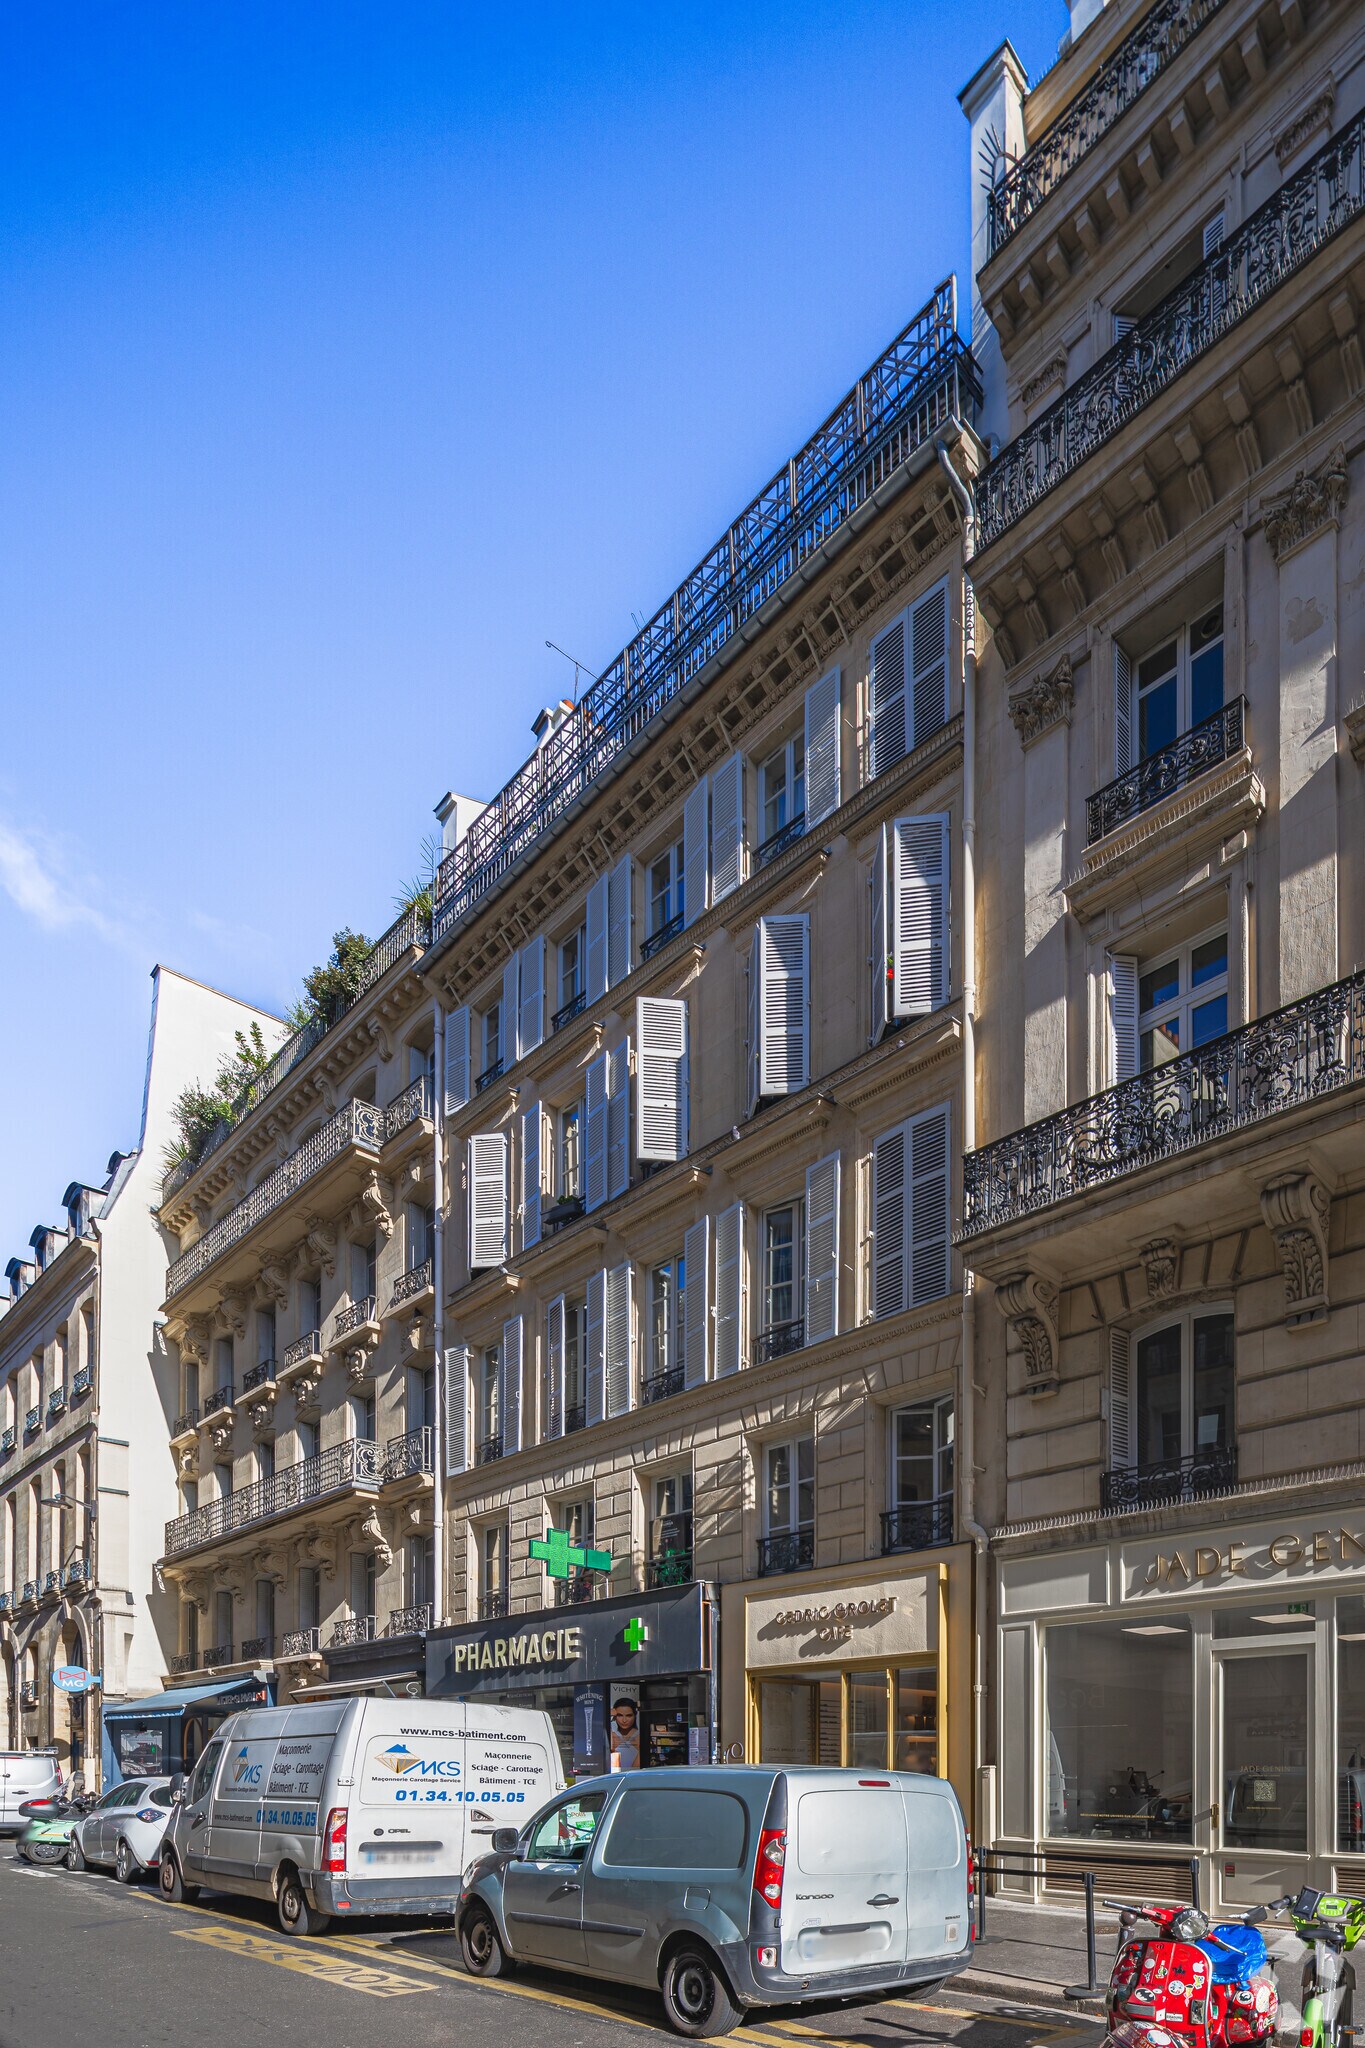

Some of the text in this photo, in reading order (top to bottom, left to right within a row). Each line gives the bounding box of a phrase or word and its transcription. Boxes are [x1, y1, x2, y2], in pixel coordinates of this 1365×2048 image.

[1145, 1540, 1245, 1584] JADE
[833, 1596, 899, 1619] GROLET
[454, 1626, 582, 1673] PHARMACIE
[61, 1679, 84, 1688] MG
[400, 1727, 527, 1741] www.mcs-batiment.com
[278, 1743, 312, 1757] Maçonnerie
[484, 1751, 532, 1761] Maçonnerie
[236, 1764, 263, 1784] MCS
[272, 1762, 292, 1777] Sciage
[295, 1762, 324, 1775] Carottage
[403, 1760, 461, 1777] MCS
[471, 1764, 499, 1773] Sciage
[506, 1765, 544, 1774] Carottage
[1239, 1765, 1260, 1773] JADE
[268, 1781, 294, 1794] Bâtiment
[298, 1782, 310, 1794] TCE
[479, 1777, 516, 1785] Bâtiment
[395, 1790, 525, 1803] 01.34.10.05.05
[256, 1809, 317, 1827] 01.34.10.05.05
